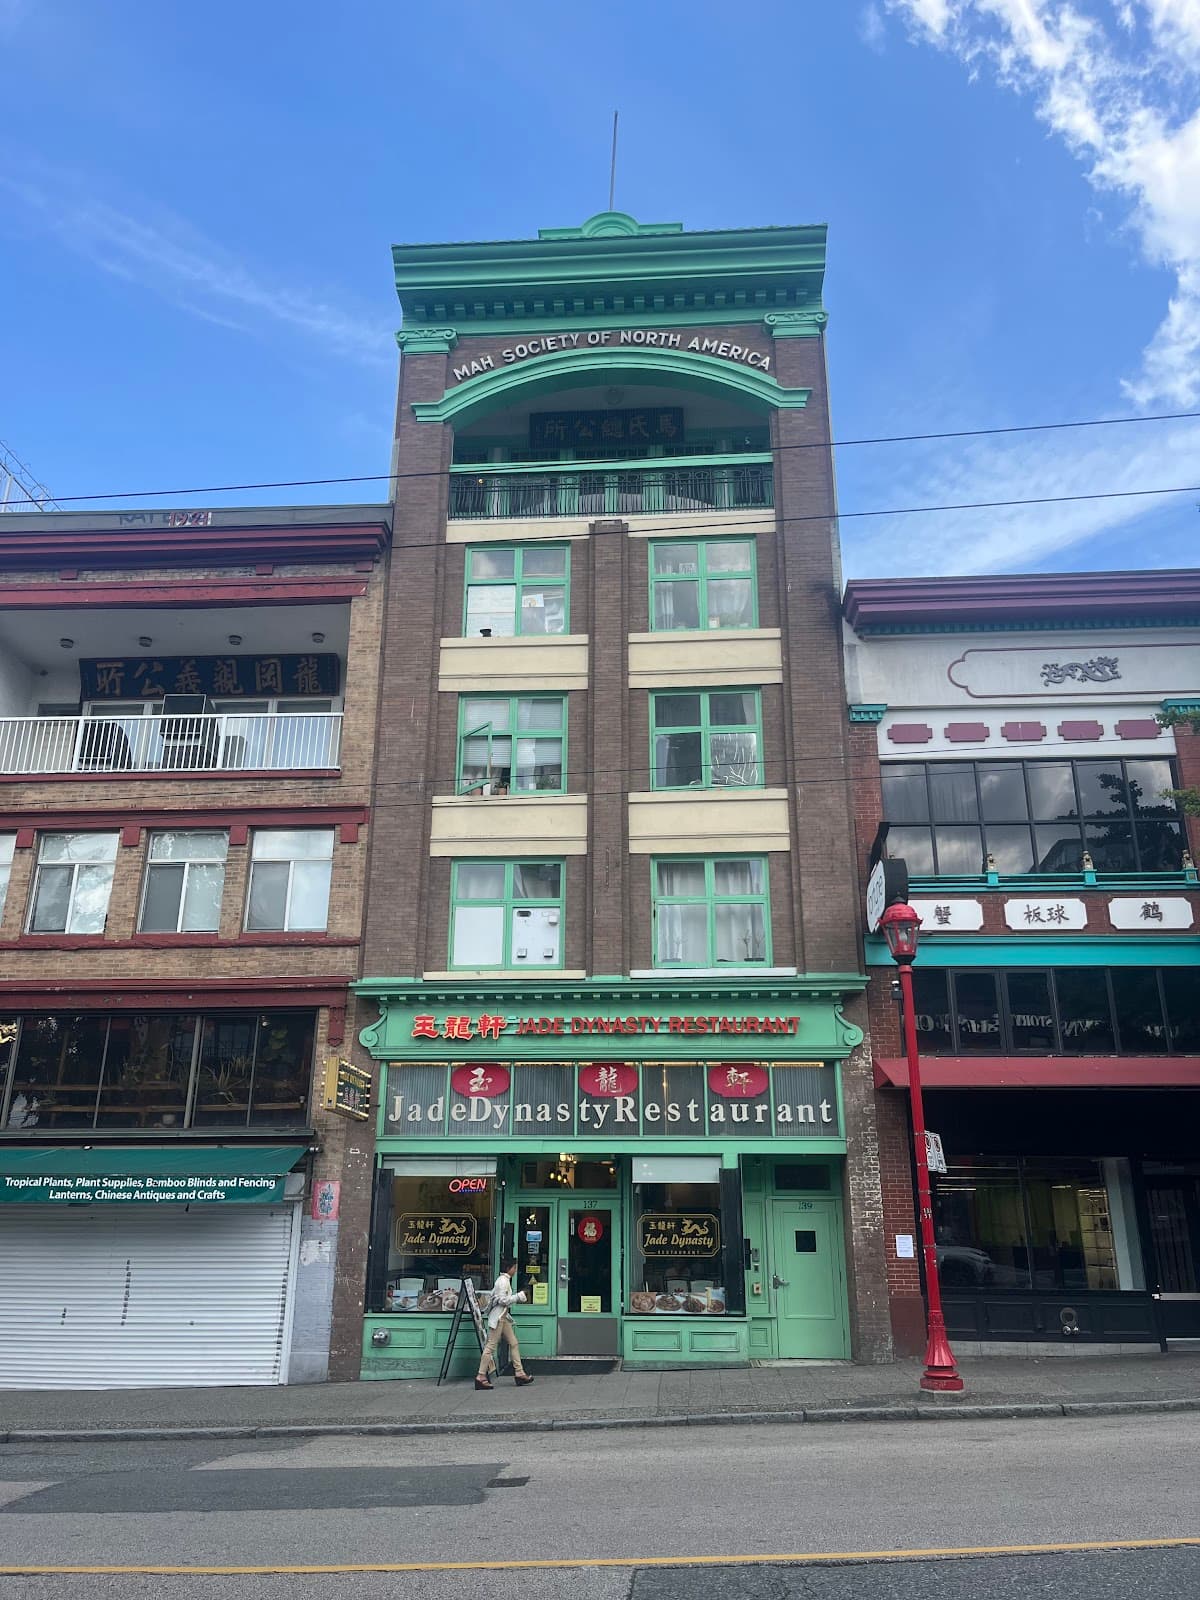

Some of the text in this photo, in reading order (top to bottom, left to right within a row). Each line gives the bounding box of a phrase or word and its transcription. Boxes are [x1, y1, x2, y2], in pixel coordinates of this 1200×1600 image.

[453, 331, 771, 381] MAH SOCIETY OF NORTH AMERICA
[933, 904, 952, 925] 蟹
[516, 1017, 565, 1035] JADE
[571, 1016, 663, 1034] DYNASTY
[669, 1016, 800, 1034] RESTAURANT
[469, 1065, 753, 1094] 玉 龍 軒
[5, 1177, 276, 1190] Tropical Plants, Plant Supplies, Bamboo Blinds and Fencing
[449, 1178, 487, 1193] OPEN
[49, 1190, 226, 1202] Lanterns, Chinese Antiques and Crafts
[583, 1200, 598, 1209] 137
[401, 1232, 471, 1247] Jade Dynasty
[643, 1233, 713, 1248] Jade Dynasty
